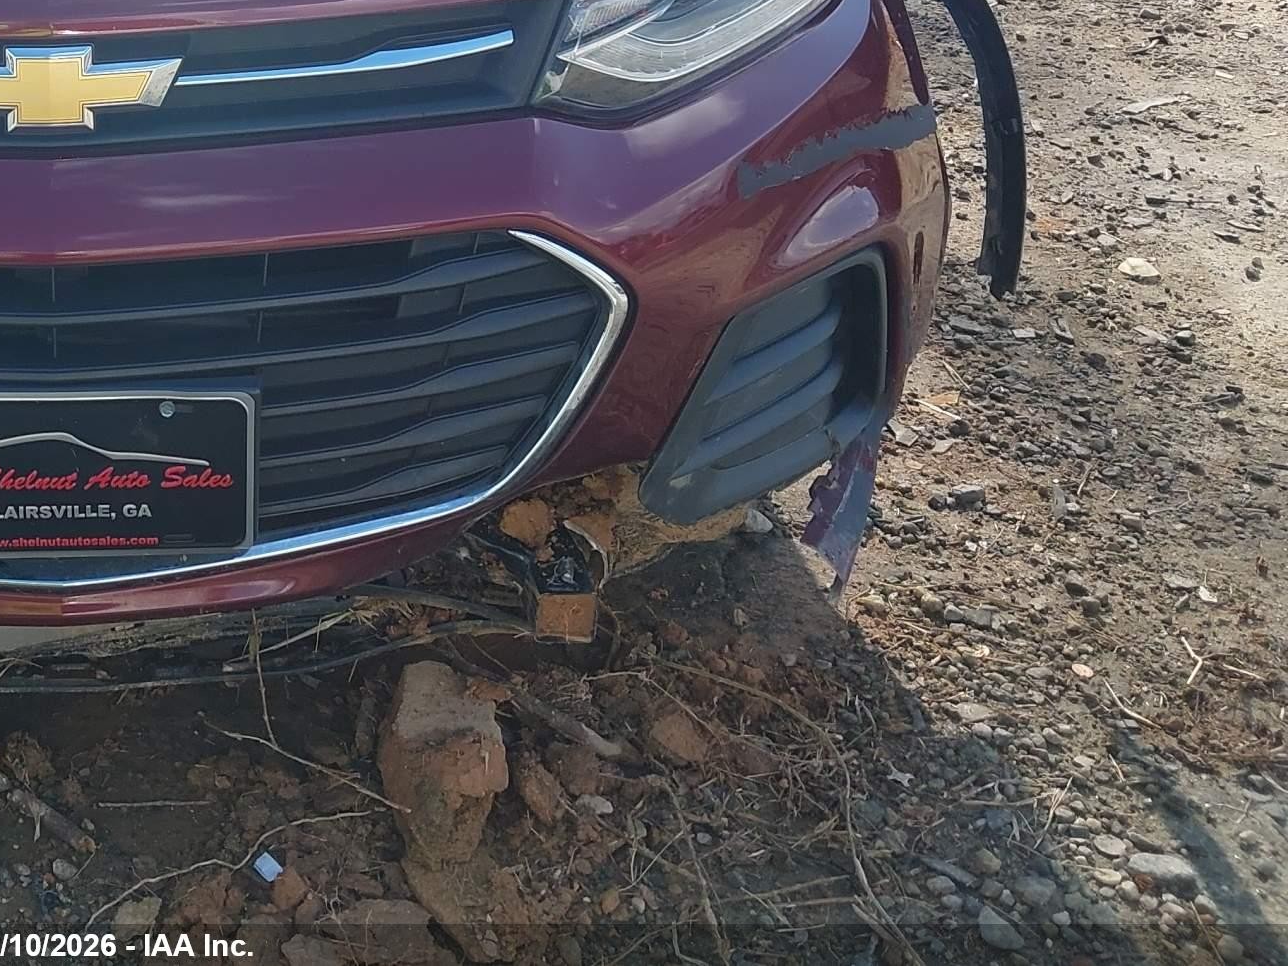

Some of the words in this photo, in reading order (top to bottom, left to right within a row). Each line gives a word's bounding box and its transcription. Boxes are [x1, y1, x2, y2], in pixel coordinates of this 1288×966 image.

[84, 466, 151, 491] Auto
[160, 465, 234, 489] Sales
[123, 504, 153, 519] GA
